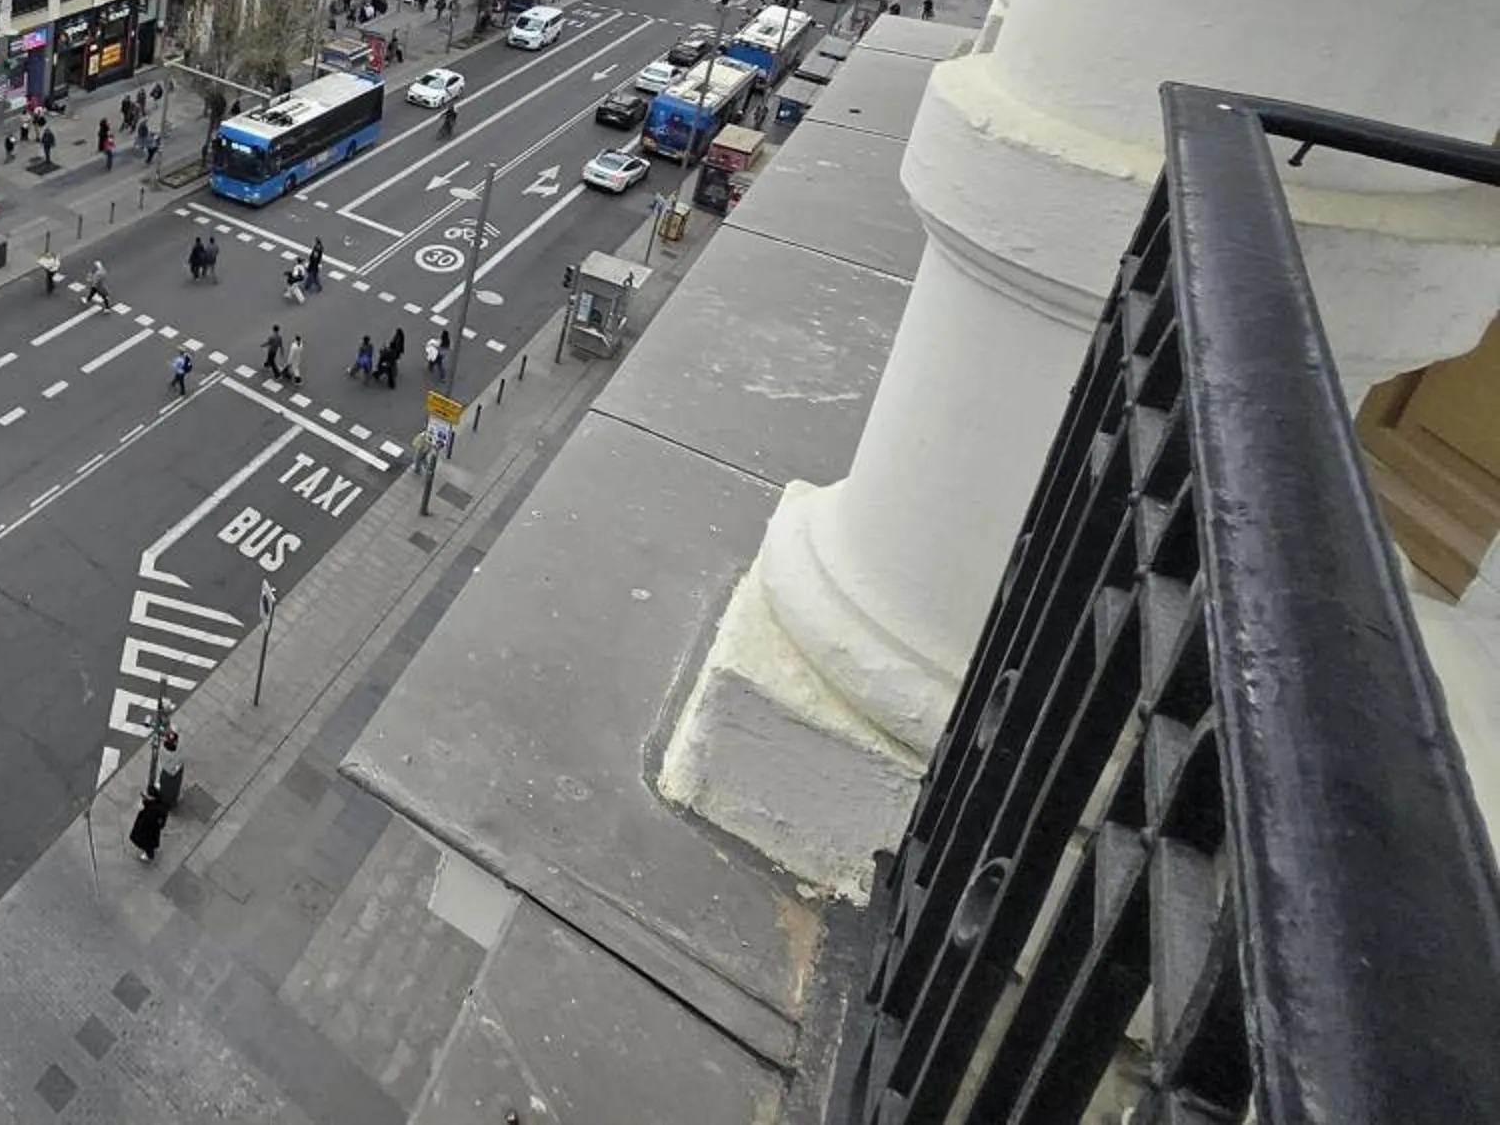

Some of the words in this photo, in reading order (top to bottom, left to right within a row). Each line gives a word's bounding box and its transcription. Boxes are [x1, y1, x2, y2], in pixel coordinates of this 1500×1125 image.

[425, 250, 455, 266] 30
[277, 452, 364, 518] TAXI
[217, 506, 302, 572] BUS
